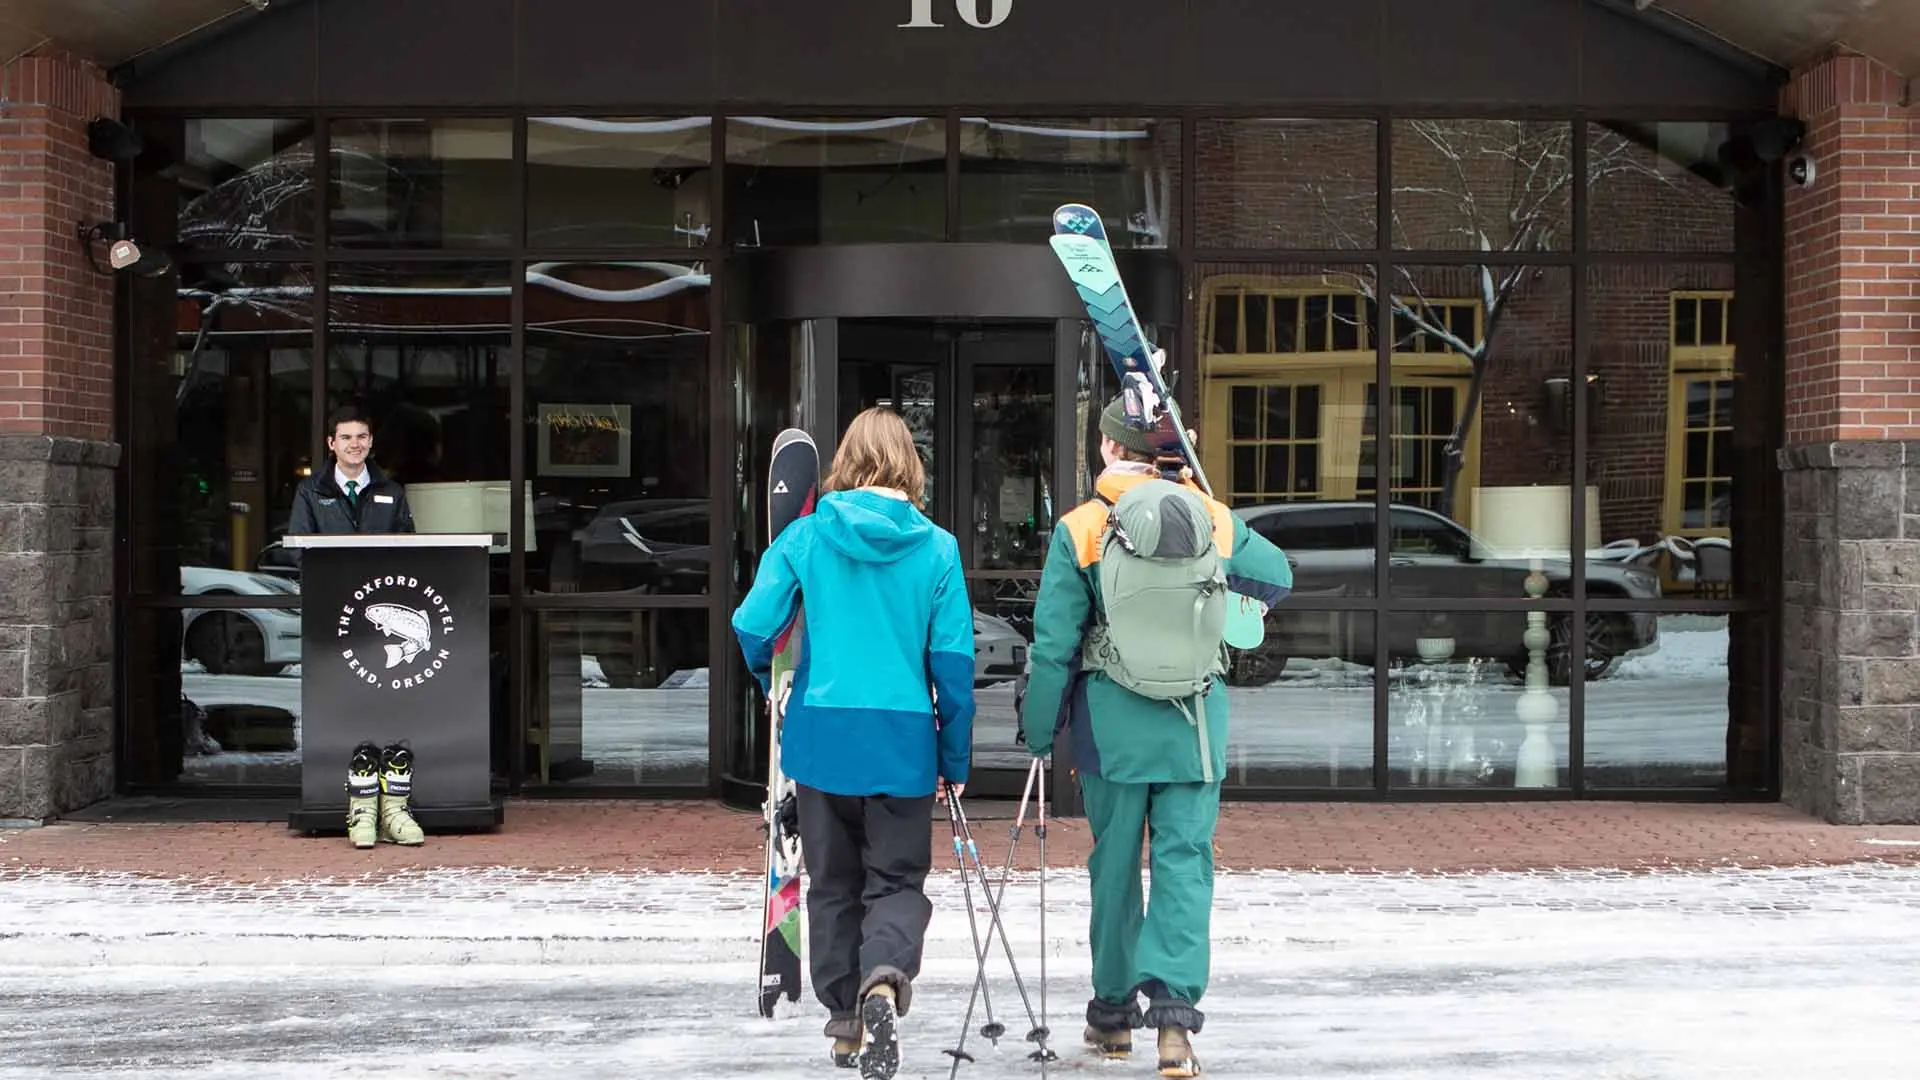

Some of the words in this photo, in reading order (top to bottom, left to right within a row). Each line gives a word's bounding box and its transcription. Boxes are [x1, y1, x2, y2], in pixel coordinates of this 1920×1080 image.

[338, 605, 355, 637] THE
[354, 575, 418, 601] OXFORD
[423, 586, 454, 635] HOTEL
[342, 649, 382, 689] BEND,
[392, 649, 450, 689] OREGON
